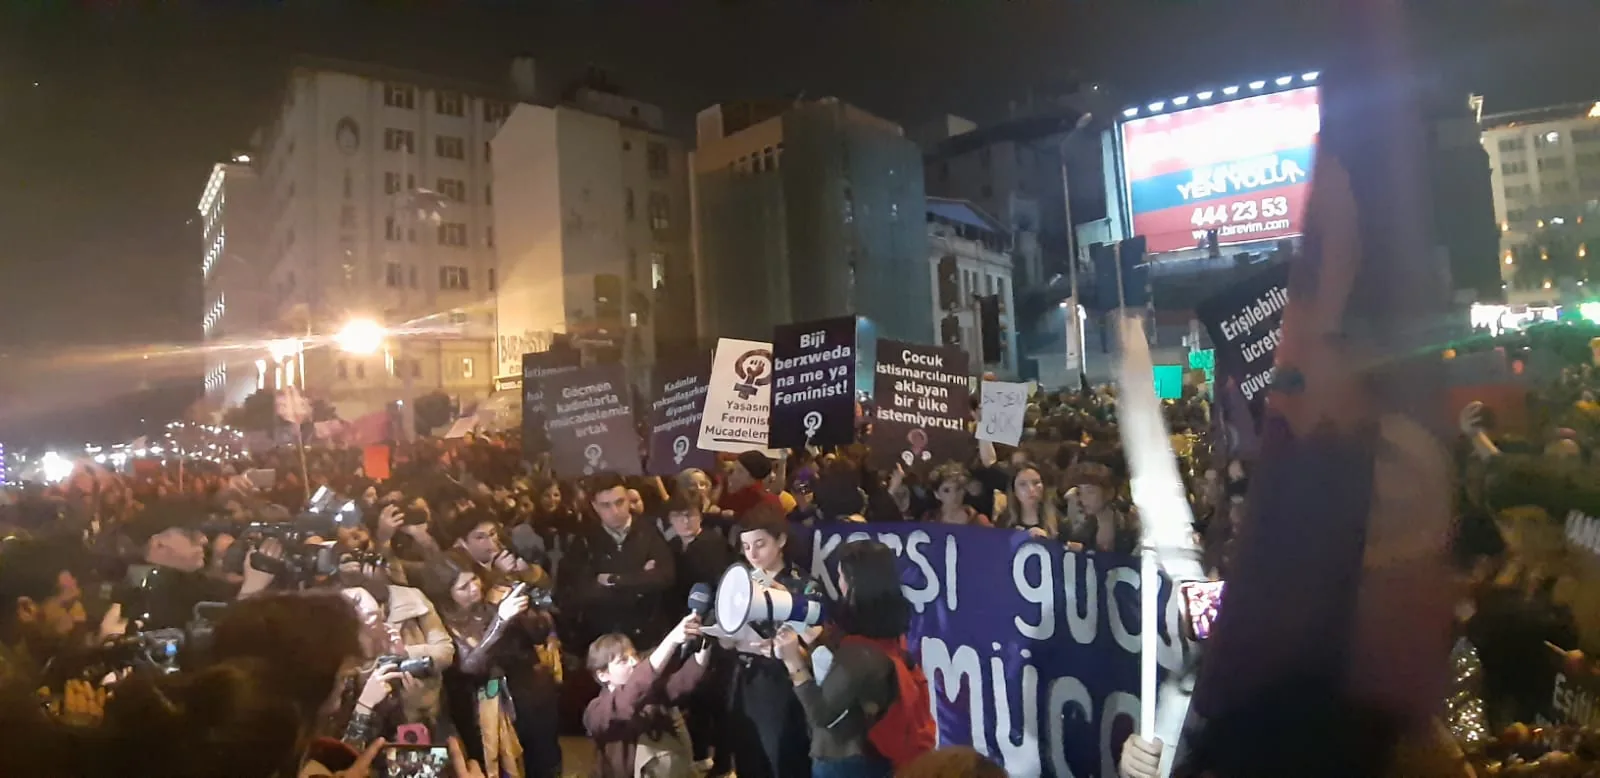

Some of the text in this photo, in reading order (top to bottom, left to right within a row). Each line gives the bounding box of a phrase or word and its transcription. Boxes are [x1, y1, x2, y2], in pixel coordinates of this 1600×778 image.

[1191, 196, 1288, 226] 444 23 53
[1220, 286, 1289, 341] Erişilebilir
[774, 345, 851, 371] berxweda
[902, 350, 943, 367] Çocuk
[776, 365, 848, 388] na me ya
[876, 362, 968, 386] istismarcılarını
[895, 380, 948, 398] aklayan
[894, 394, 948, 413] bir ülke
[877, 407, 964, 430] istemiyoruz!
[810, 529, 958, 613] KŞI
